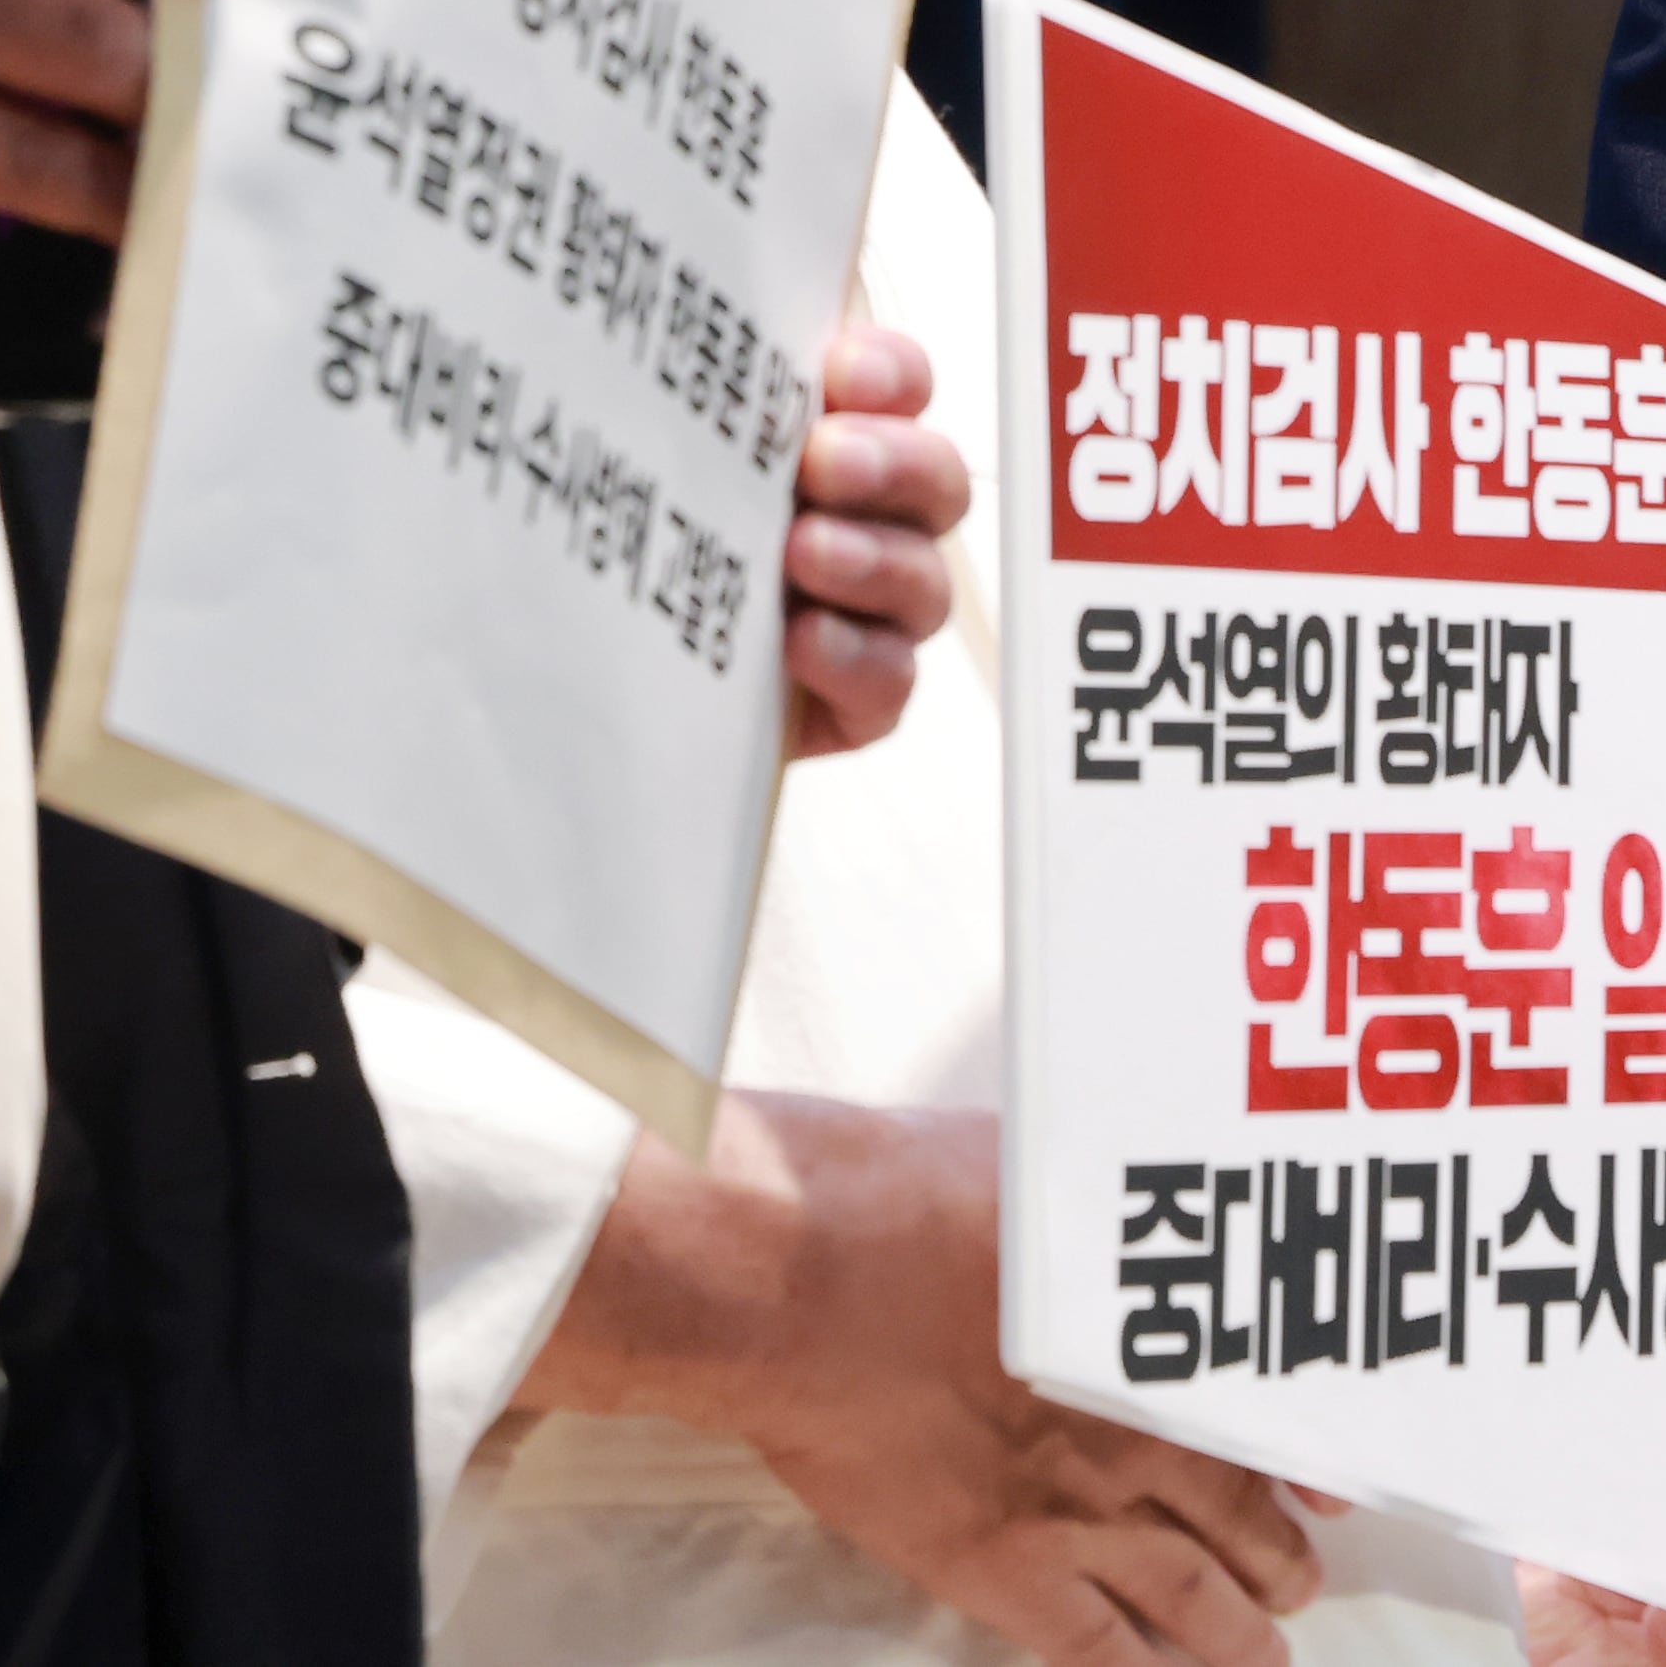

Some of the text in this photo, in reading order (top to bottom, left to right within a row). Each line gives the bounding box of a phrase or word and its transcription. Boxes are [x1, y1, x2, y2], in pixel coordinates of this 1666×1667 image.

[671, 24, 773, 209] 한동훈
[281, 19, 561, 276] 윤석열정권
[553, 172, 669, 366] 황태자
[657, 264, 759, 439] 한동훈
[1065, 312, 1431, 534] 정치검사
[651, 506, 751, 676] 고발장
[1071, 606, 1581, 788] 윤석열의 황태자
[1242, 822, 1577, 1116] 한동훈
